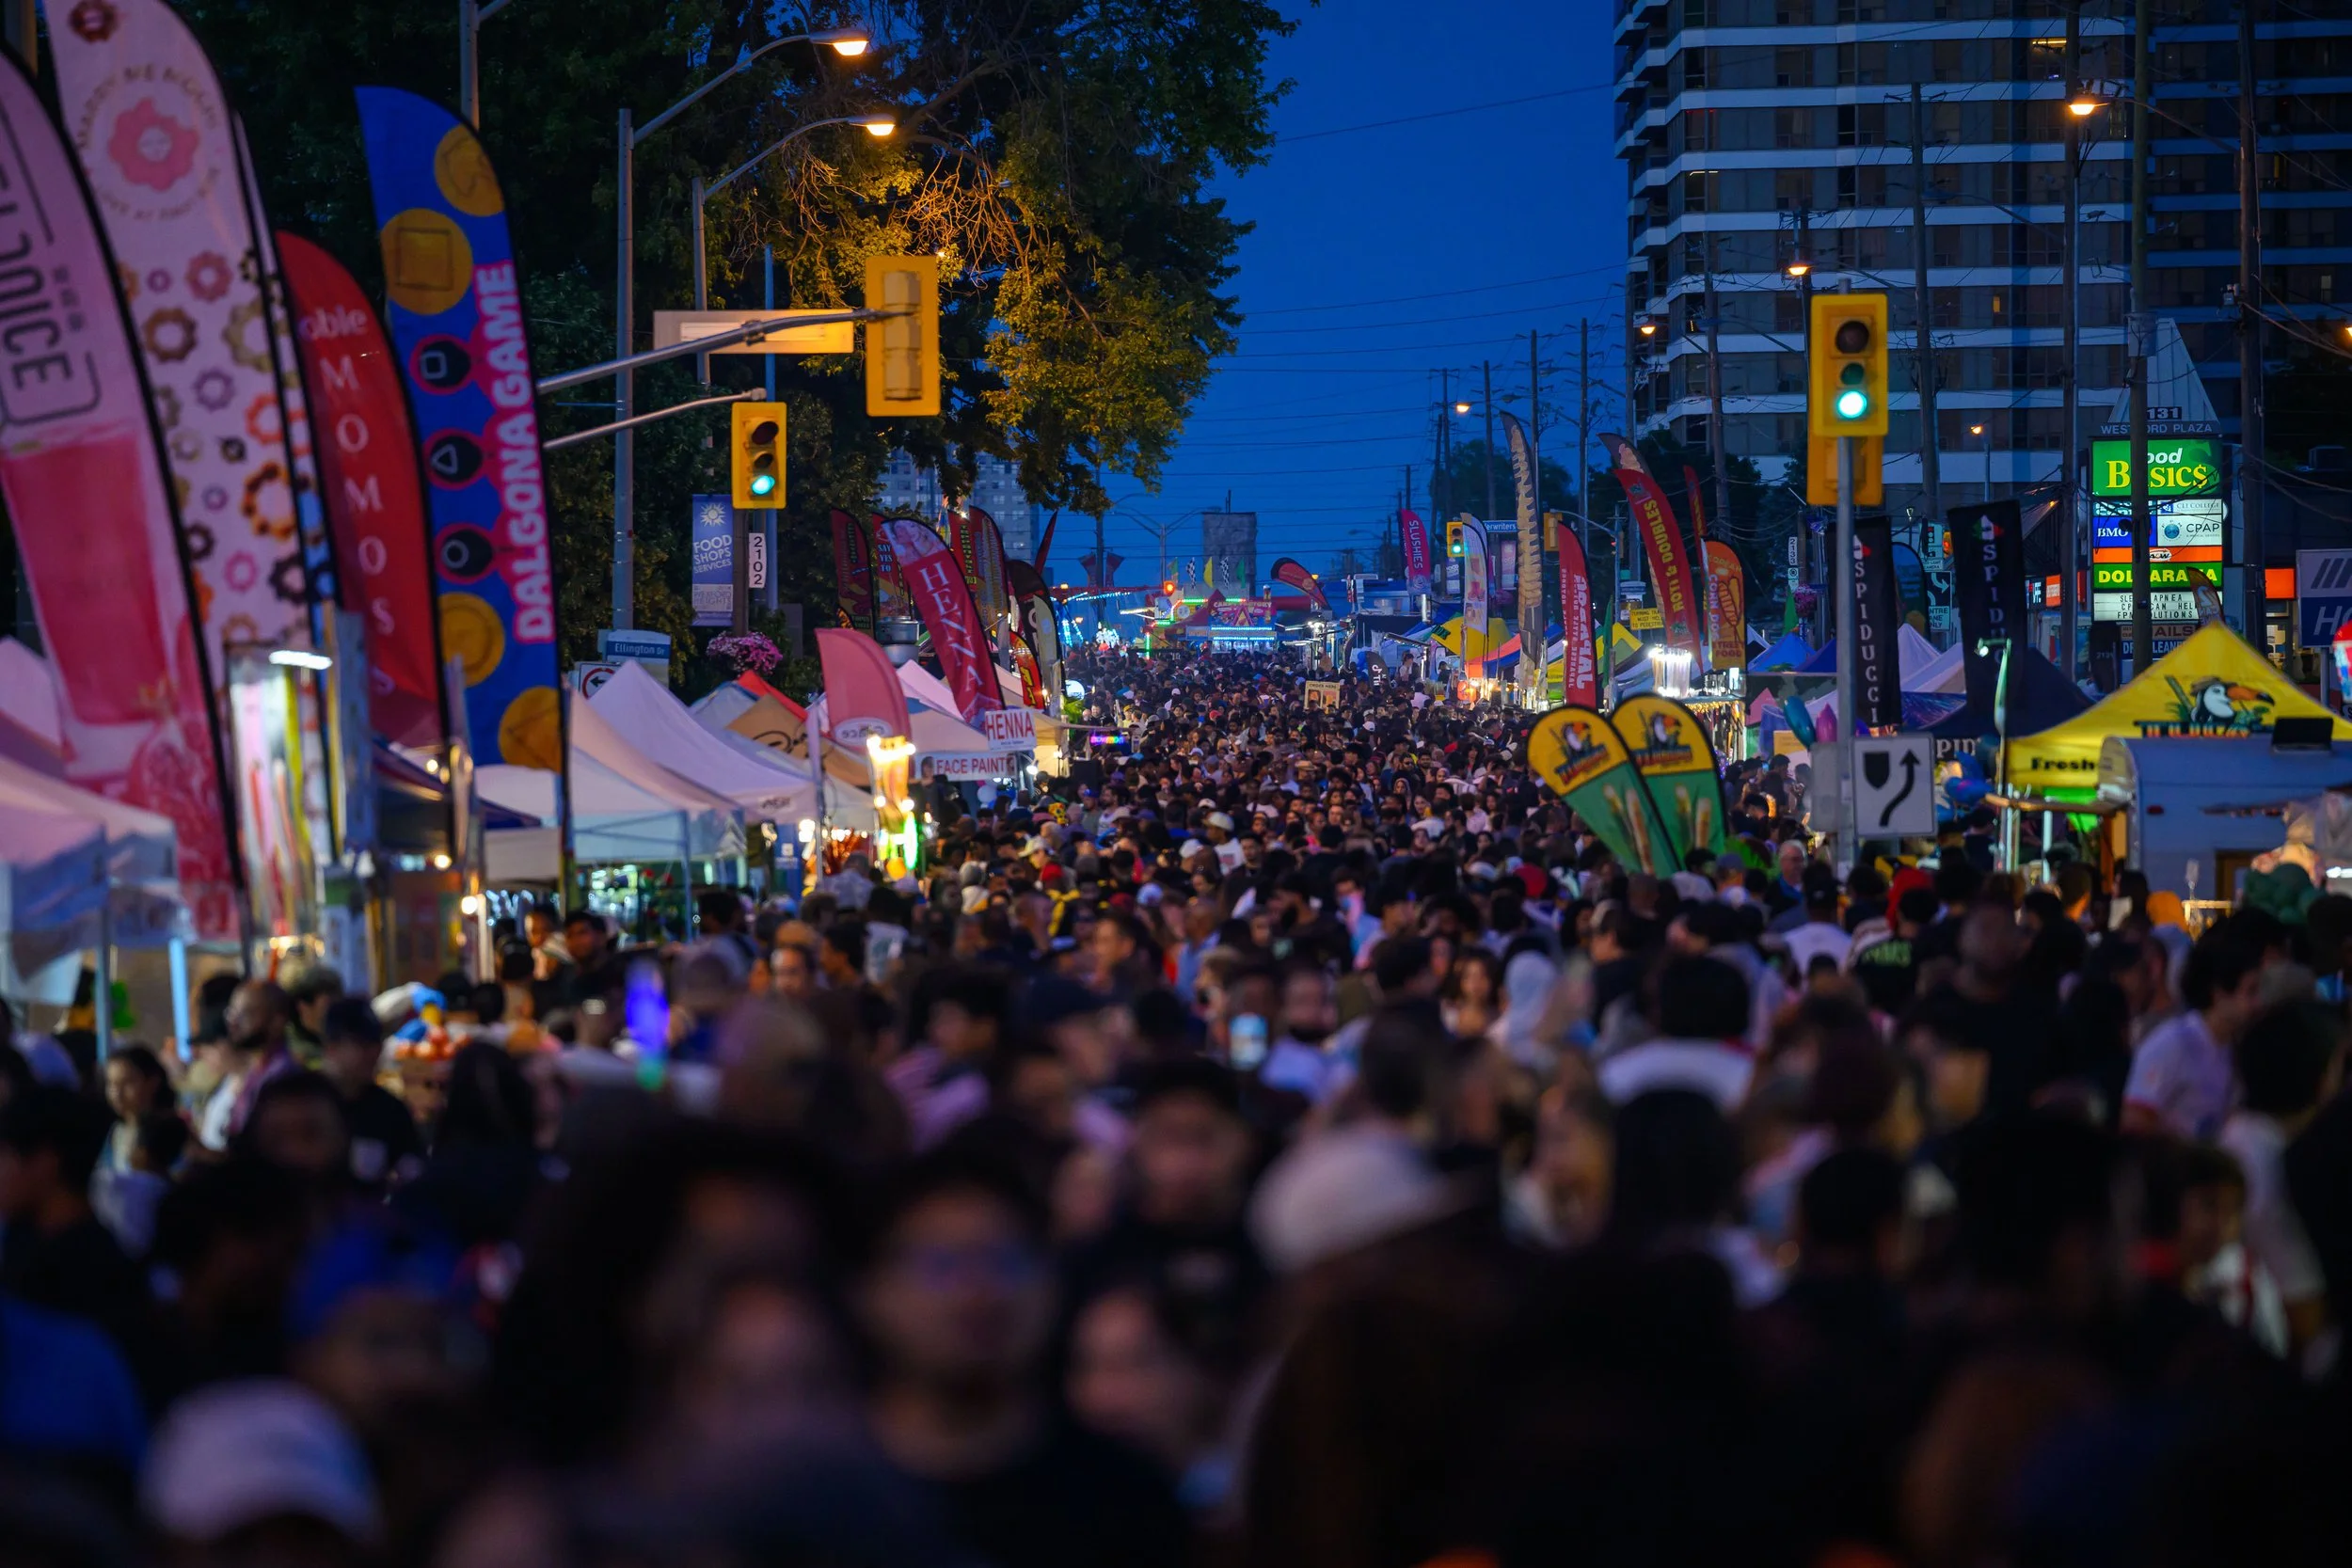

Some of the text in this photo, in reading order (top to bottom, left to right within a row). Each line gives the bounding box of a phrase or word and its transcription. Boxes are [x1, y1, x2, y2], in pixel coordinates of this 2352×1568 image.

[298, 303, 369, 341] oble
[2146, 407, 2180, 420] 131
[2173, 423, 2212, 434] PLAZA
[475, 262, 554, 641] DALGONA GAME
[2147, 448, 2184, 465] ood
[2106, 460, 2208, 489] BSIC$
[1644, 499, 1675, 563] DOUBLES
[2097, 528, 2129, 537] BMO
[2186, 523, 2220, 533] CPAP
[693, 534, 733, 554] FOOD
[878, 544, 892, 552] SAY
[1408, 519, 1423, 570] SLUSHIES
[693, 547, 732, 564] SHOPS
[754, 536, 763, 585] 2102
[880, 554, 893, 562] YES
[693, 559, 733, 574] SERVICES
[2098, 568, 2217, 583] DOLARAA
[1670, 580, 1686, 612] ROTI
[2153, 594, 2183, 602] APNEA
[2152, 610, 2193, 619] LUTIONS
[919, 562, 983, 692] HENNA
[2153, 626, 2193, 637] AILS
[614, 642, 665, 656] Ellington Dr
[1854, 562, 1880, 724] SPIDUCCI
[986, 711, 1035, 741] HENNA
[935, 758, 968, 775] FACE
[2030, 757, 2095, 771] Fresh
